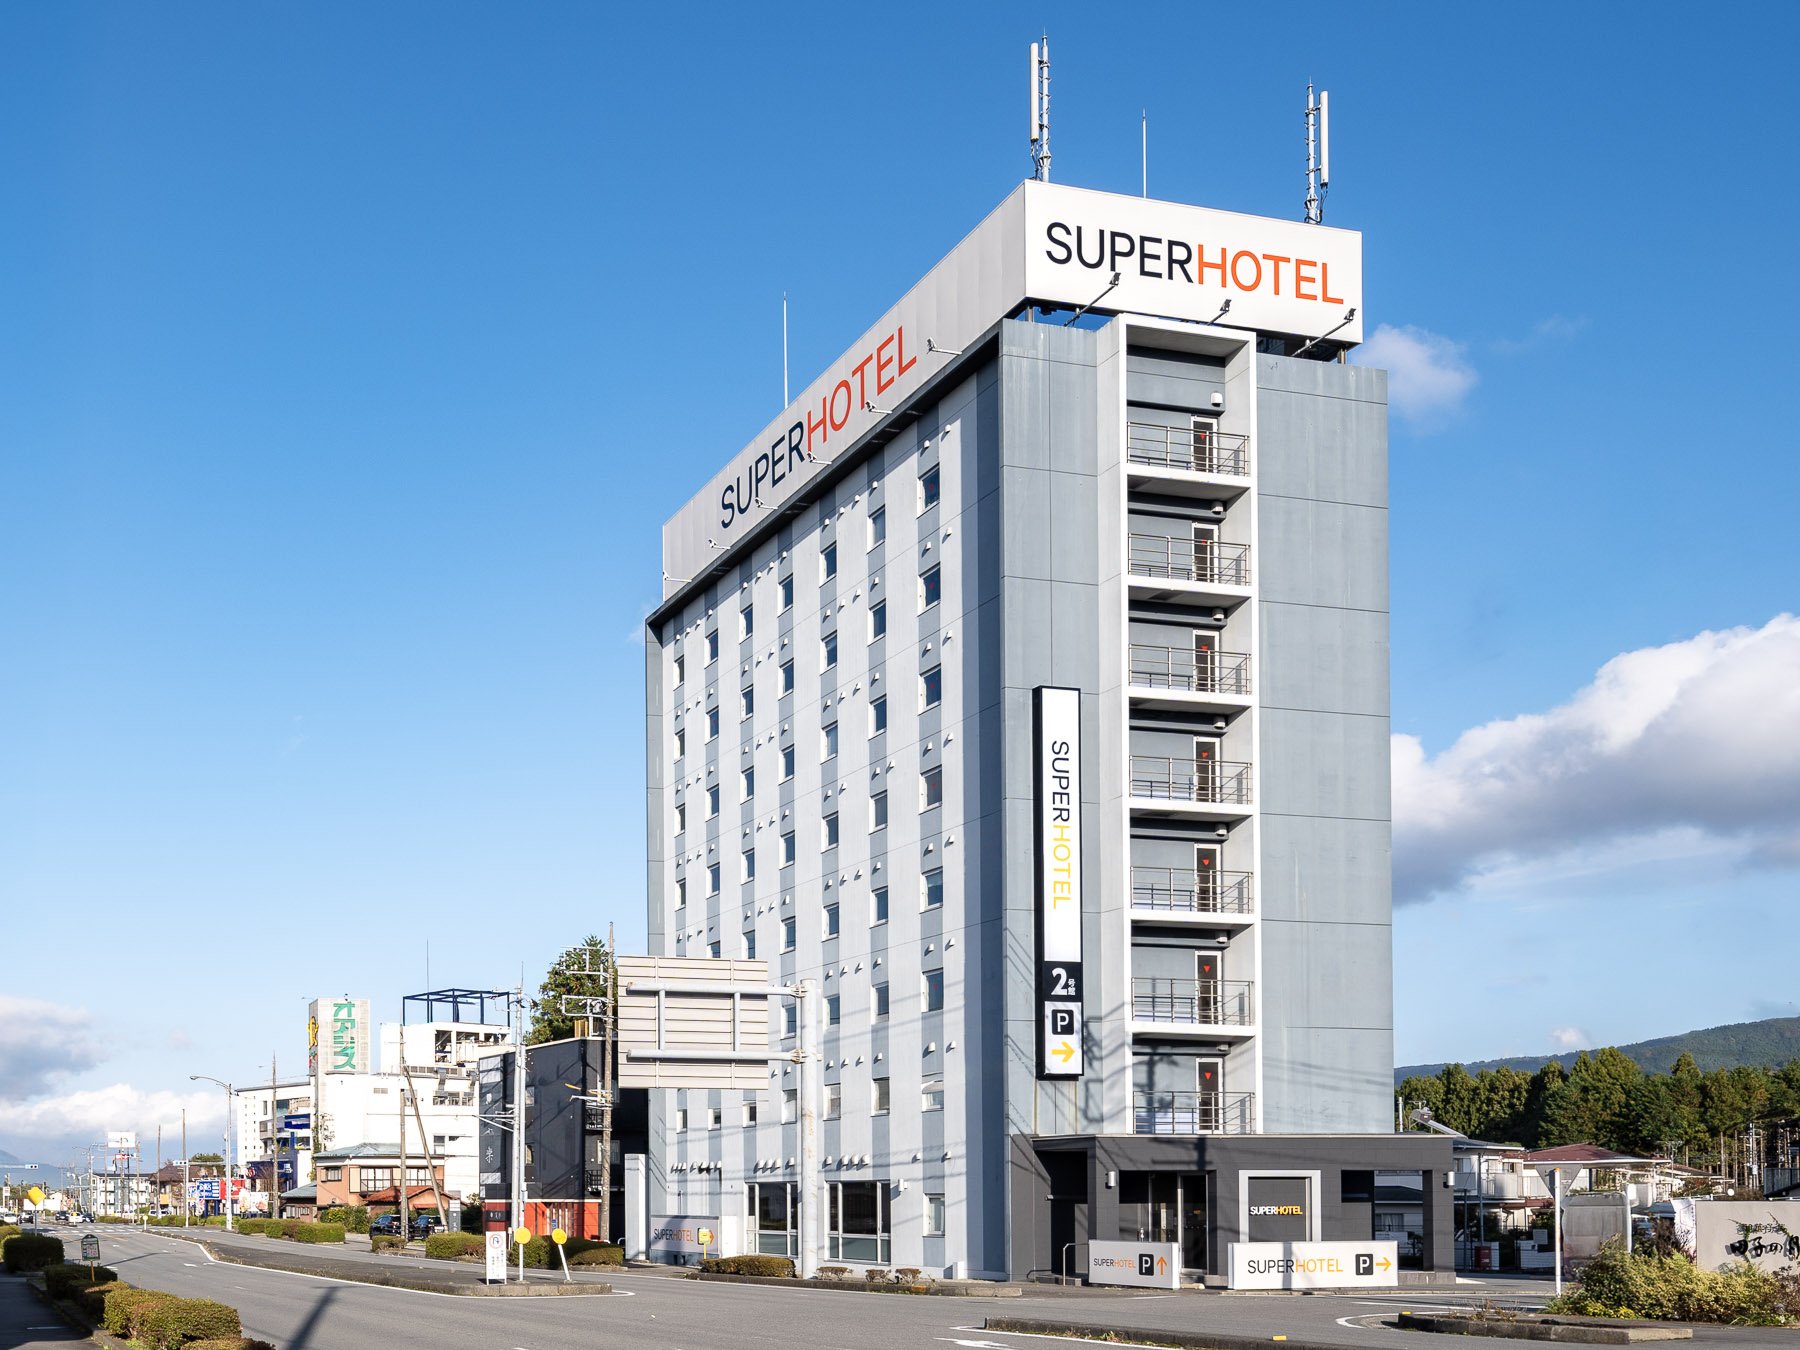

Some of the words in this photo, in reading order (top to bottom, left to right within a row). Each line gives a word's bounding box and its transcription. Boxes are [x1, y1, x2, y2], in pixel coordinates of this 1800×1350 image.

[1045, 221, 1345, 305] SUPERHOTEL
[721, 325, 917, 529] SUPERHOTEL
[1051, 740, 1071, 910] SUPERHOTEL
[1056, 1012, 1069, 1032] P
[1250, 1206, 1304, 1215] SUPERHOTEL
[653, 1228, 694, 1242] SUPERHOTEL
[1093, 1257, 1136, 1269] SUPERHOTEL
[1142, 1256, 1151, 1273] P
[1247, 1258, 1344, 1274] SUPERHOTEL
[1359, 1256, 1370, 1274] P
